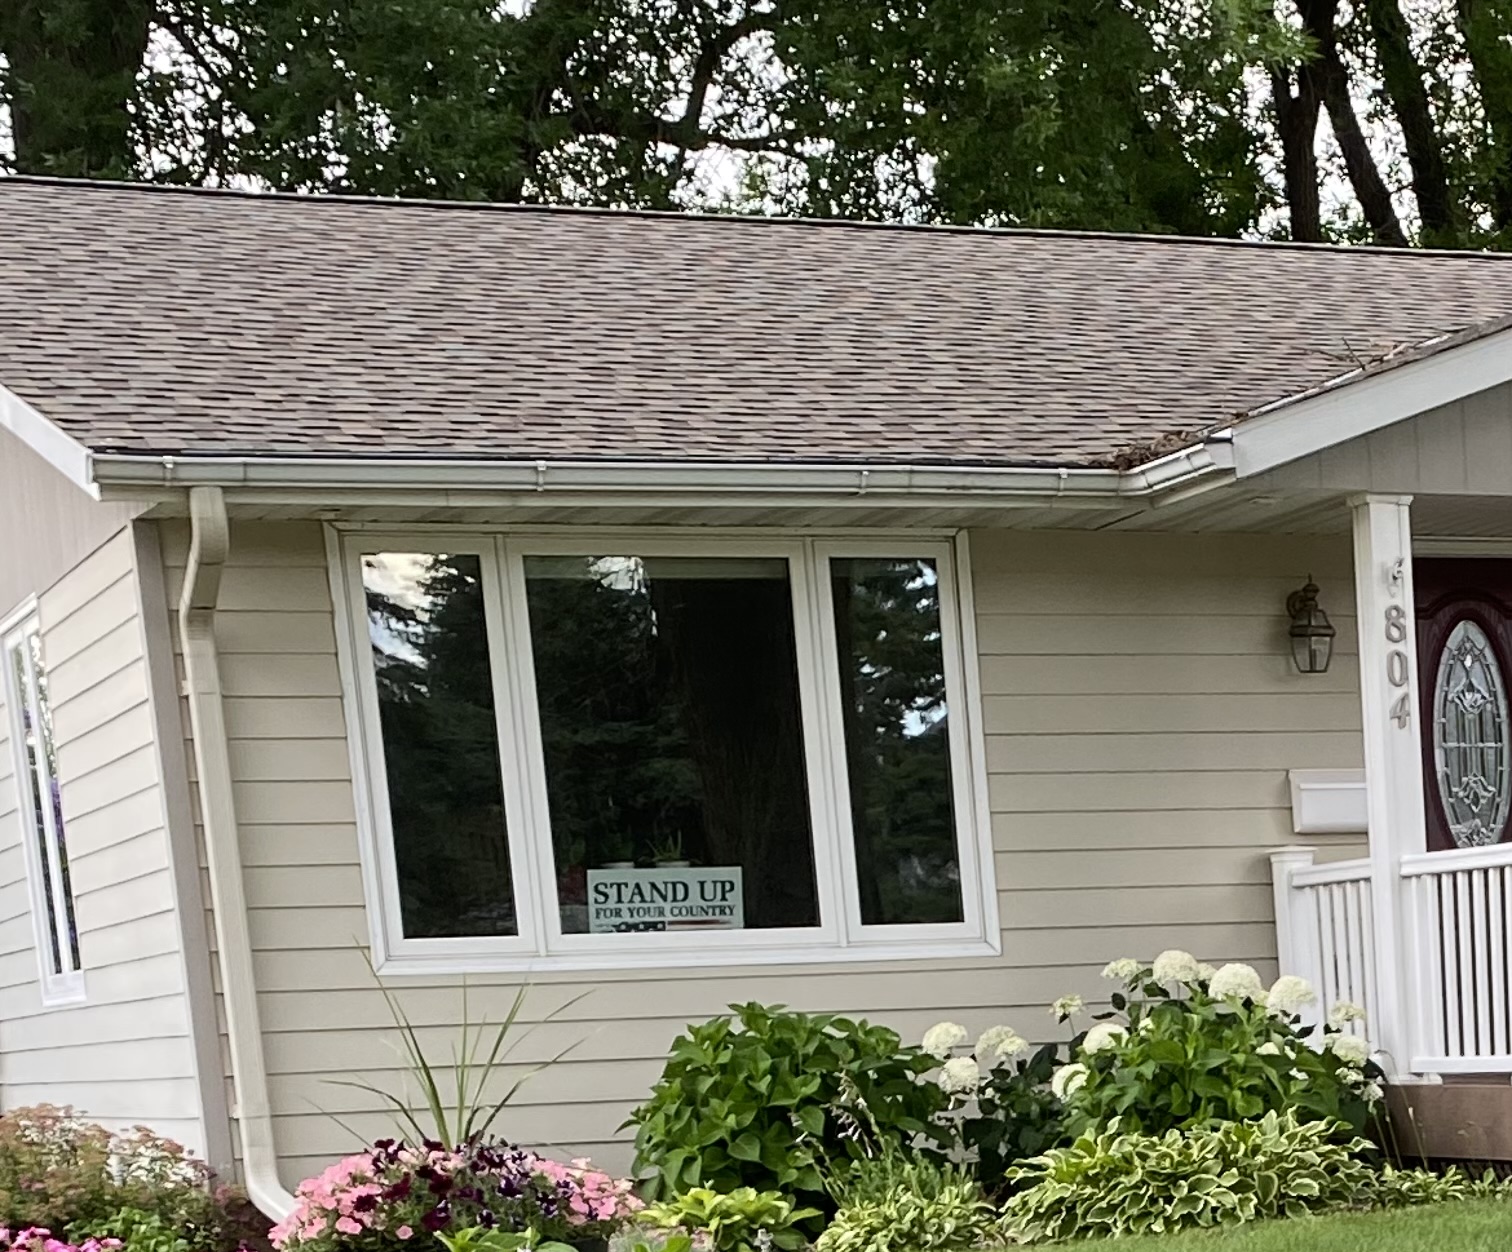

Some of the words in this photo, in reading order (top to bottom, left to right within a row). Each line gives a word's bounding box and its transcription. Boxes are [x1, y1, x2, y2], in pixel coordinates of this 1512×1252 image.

[1385, 605, 1410, 730] 804
[593, 881, 690, 905] STAND
[697, 880, 735, 902] UP
[595, 907, 623, 919] FOR
[627, 906, 666, 918] YOUR
[670, 905, 736, 917] COUNTRY
